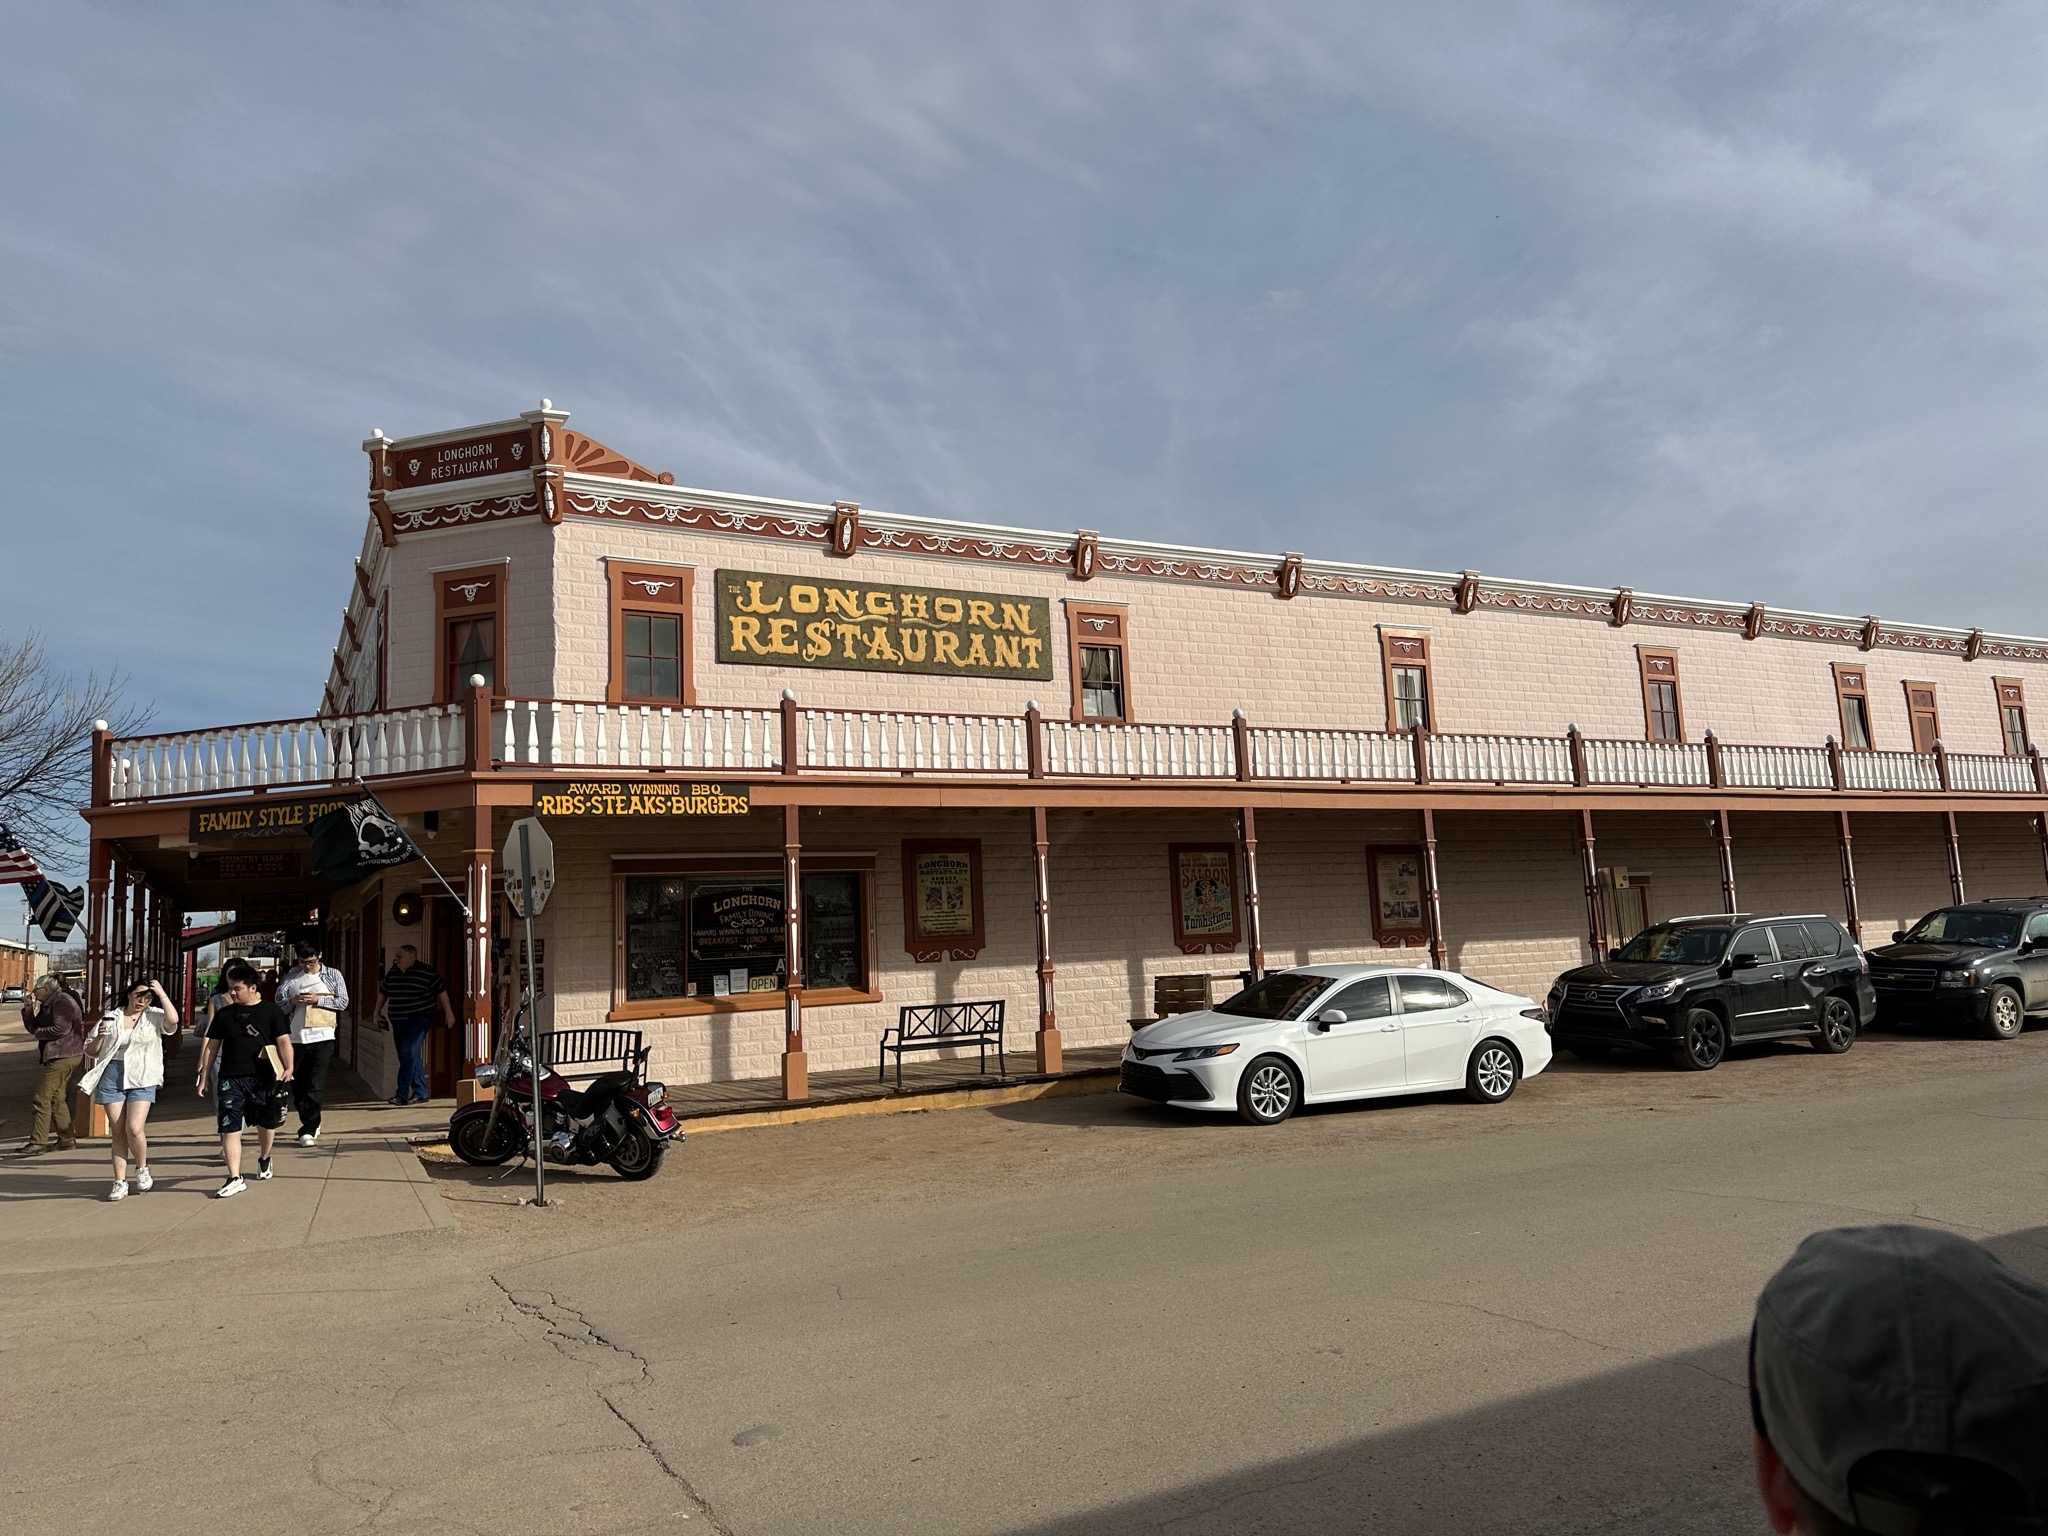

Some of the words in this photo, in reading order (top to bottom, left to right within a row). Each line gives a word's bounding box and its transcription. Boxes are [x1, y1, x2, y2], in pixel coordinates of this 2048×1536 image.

[438, 443, 493, 463] LONGHORN
[431, 457, 500, 480] RESTAURANT
[728, 585, 740, 594] THE
[736, 580, 1038, 635] LONGHORN
[729, 616, 1042, 670] RESTAURANT
[567, 784, 621, 795] AWARD
[629, 784, 680, 796] WINNING
[691, 784, 724, 796] BBQ
[199, 809, 254, 832] FAMILY
[257, 805, 304, 827] STYLE
[219, 855, 259, 864] COUNTRY
[262, 854, 283, 863] HAM
[219, 863, 248, 872] STEAK
[257, 863, 284, 871] EGGS
[918, 860, 968, 869] LONGHORN
[1182, 867, 1230, 889] SALOON
[712, 895, 782, 914] LONGHORN
[719, 910, 747, 925] FAMILY
[748, 908, 776, 923] DINING
[1184, 911, 1231, 930] Tombstone
[699, 936, 738, 946] BREAKFAST
[746, 935, 767, 944] LUNCH
[718, 928, 744, 936] WINNING
[751, 978, 776, 990] OPEN
